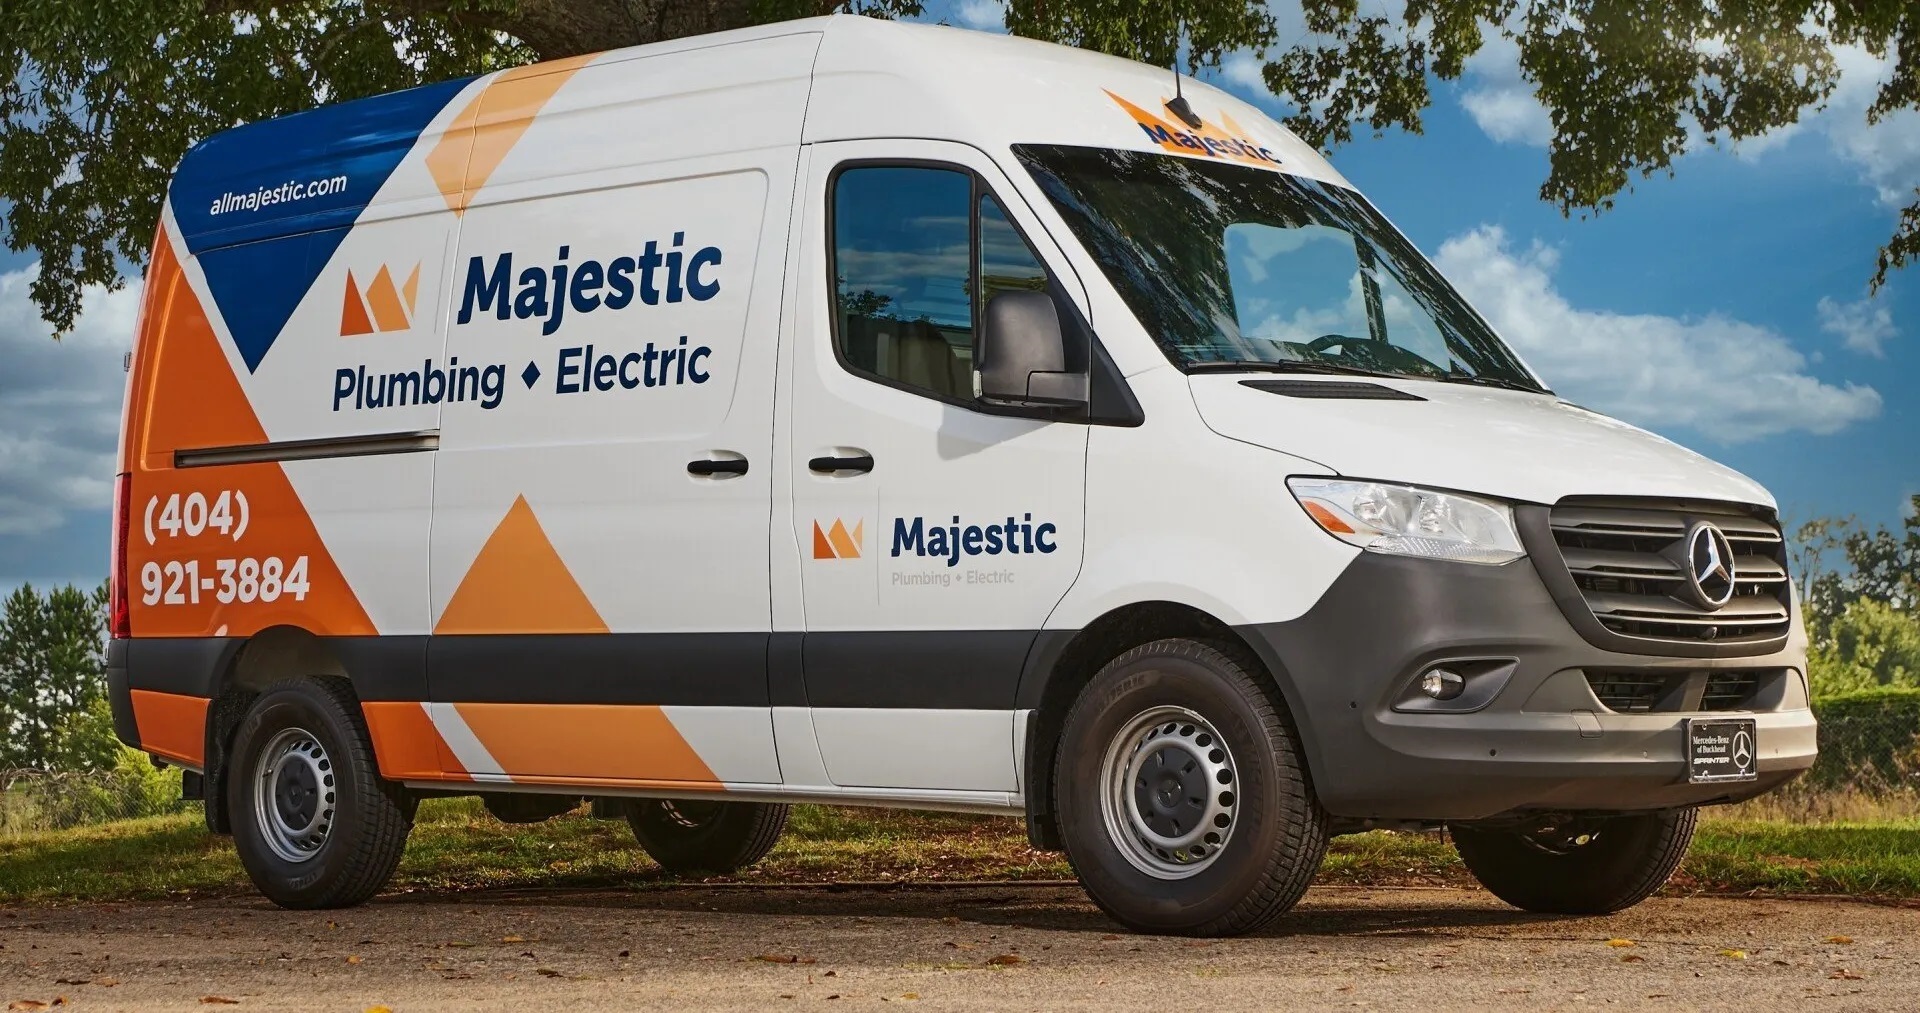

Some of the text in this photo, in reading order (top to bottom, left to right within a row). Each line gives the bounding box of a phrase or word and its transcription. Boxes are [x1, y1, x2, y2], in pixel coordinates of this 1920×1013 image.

[1137, 121, 1283, 164] Majestic
[210, 175, 348, 216] allmajestic.com
[457, 231, 722, 336] Majestic
[333, 335, 712, 410] Plumbing Electric
[144, 489, 249, 546] (404)
[891, 513, 1057, 567] Majestic
[141, 555, 310, 606] 921-3884
[892, 569, 1015, 587] Plumbing Electric
[1692, 735, 1730, 745] Mercedes-Benz
[1693, 757, 1730, 765] SPRINTER
[1696, 745, 1702, 754] of
